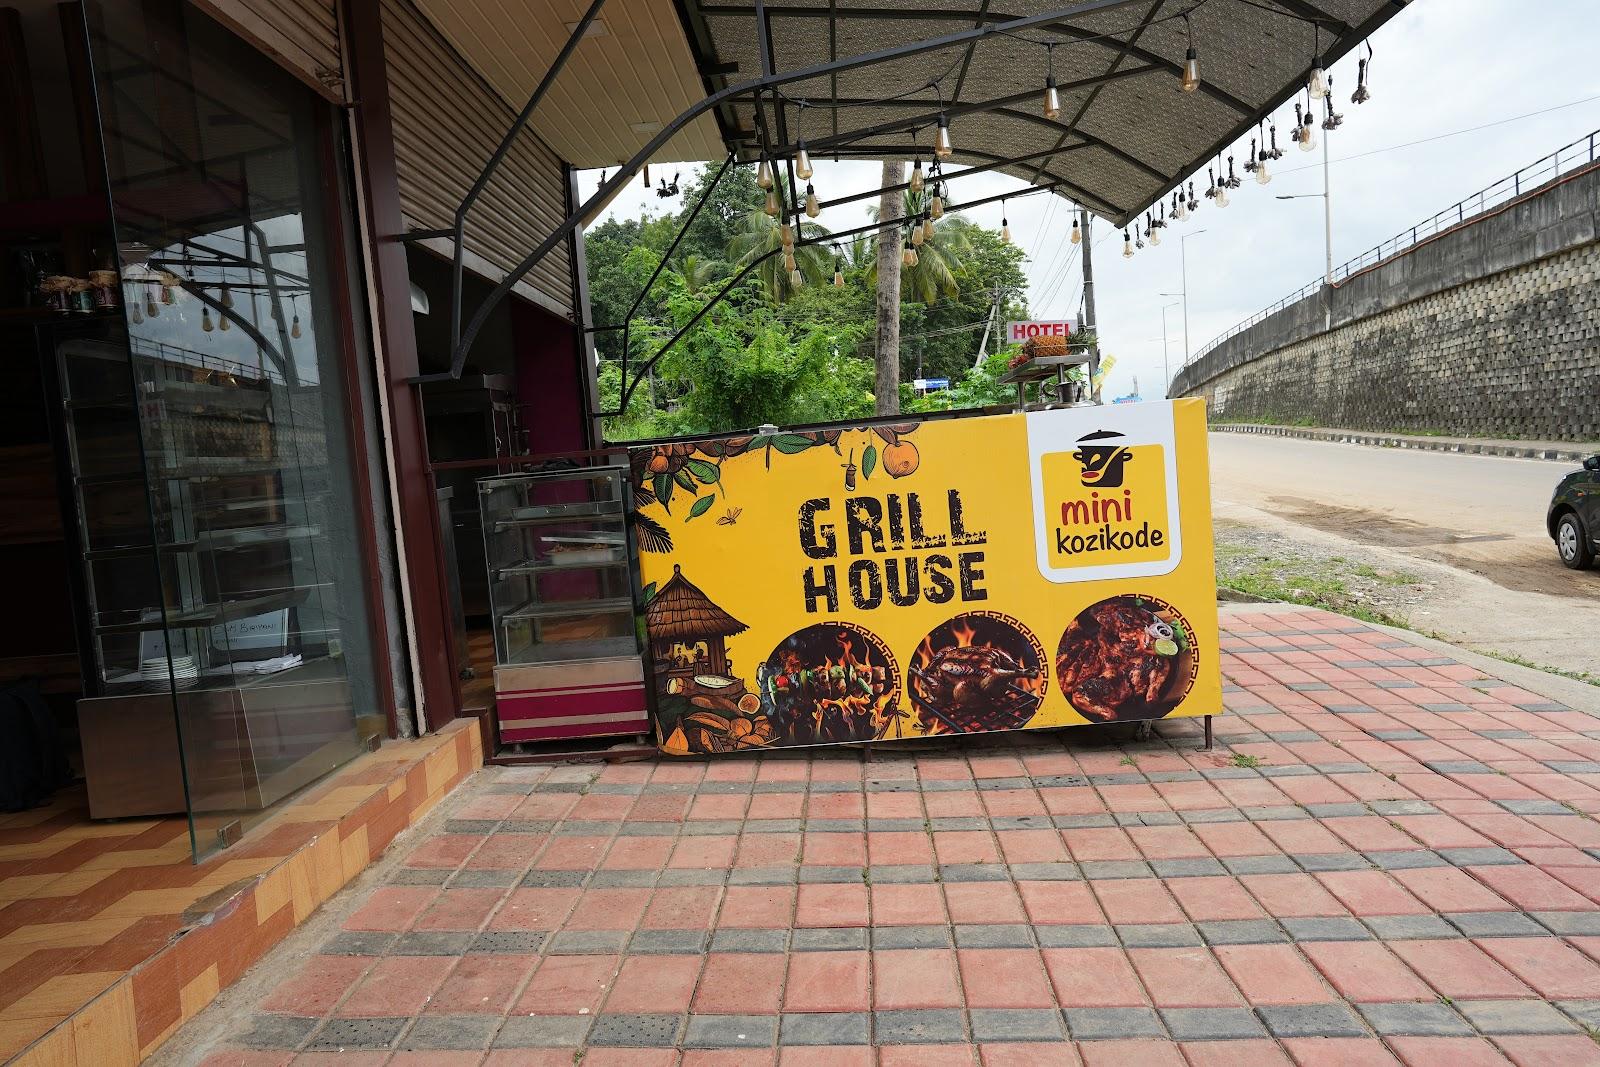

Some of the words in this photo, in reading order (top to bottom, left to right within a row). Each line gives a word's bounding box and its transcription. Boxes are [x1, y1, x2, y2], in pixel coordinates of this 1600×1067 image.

[798, 489, 987, 559] GRILL
[1061, 489, 1132, 526] mini
[1056, 521, 1164, 555] kozikode
[802, 551, 988, 613] HOUSE
